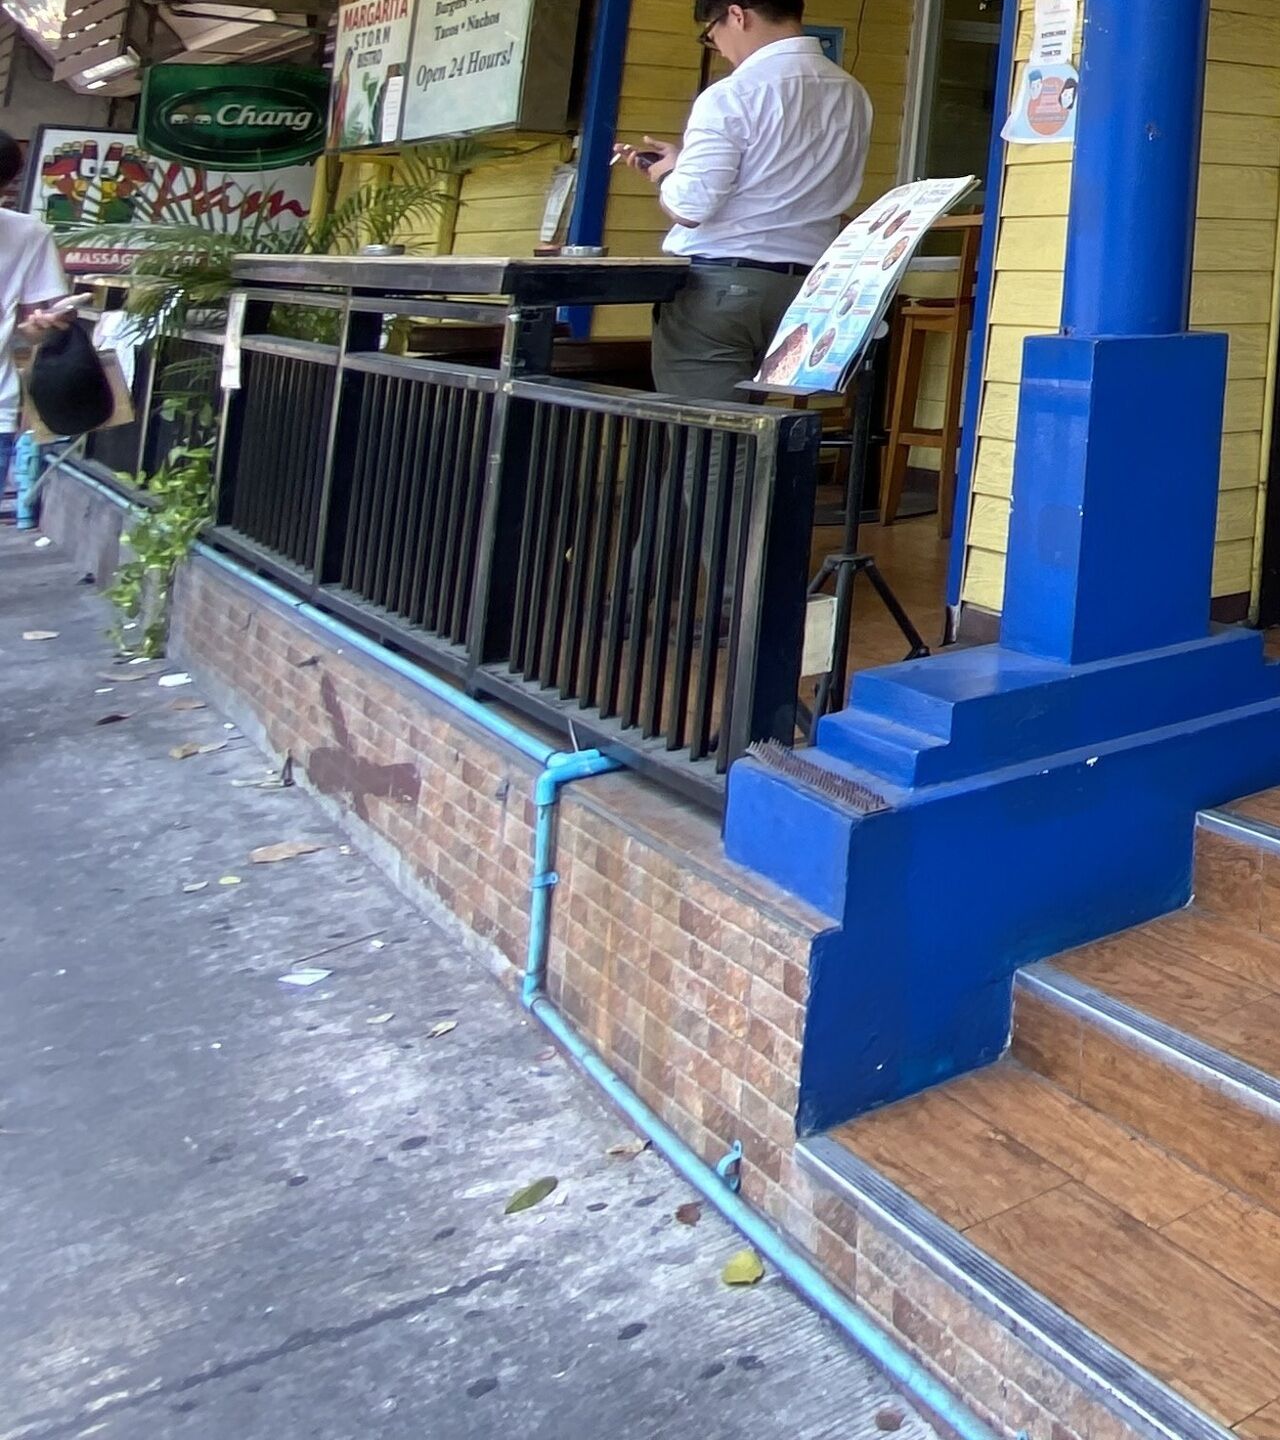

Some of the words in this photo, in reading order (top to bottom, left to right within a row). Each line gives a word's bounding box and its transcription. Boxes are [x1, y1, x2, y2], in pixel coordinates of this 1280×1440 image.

[353, 26, 391, 51] STORM
[434, 25, 459, 41] Tacos
[466, 10, 500, 32] Nachos
[416, 64, 447, 92] Open
[448, 54, 465, 79] 24
[466, 41, 514, 75] Hours!
[216, 104, 313, 131] Chang
